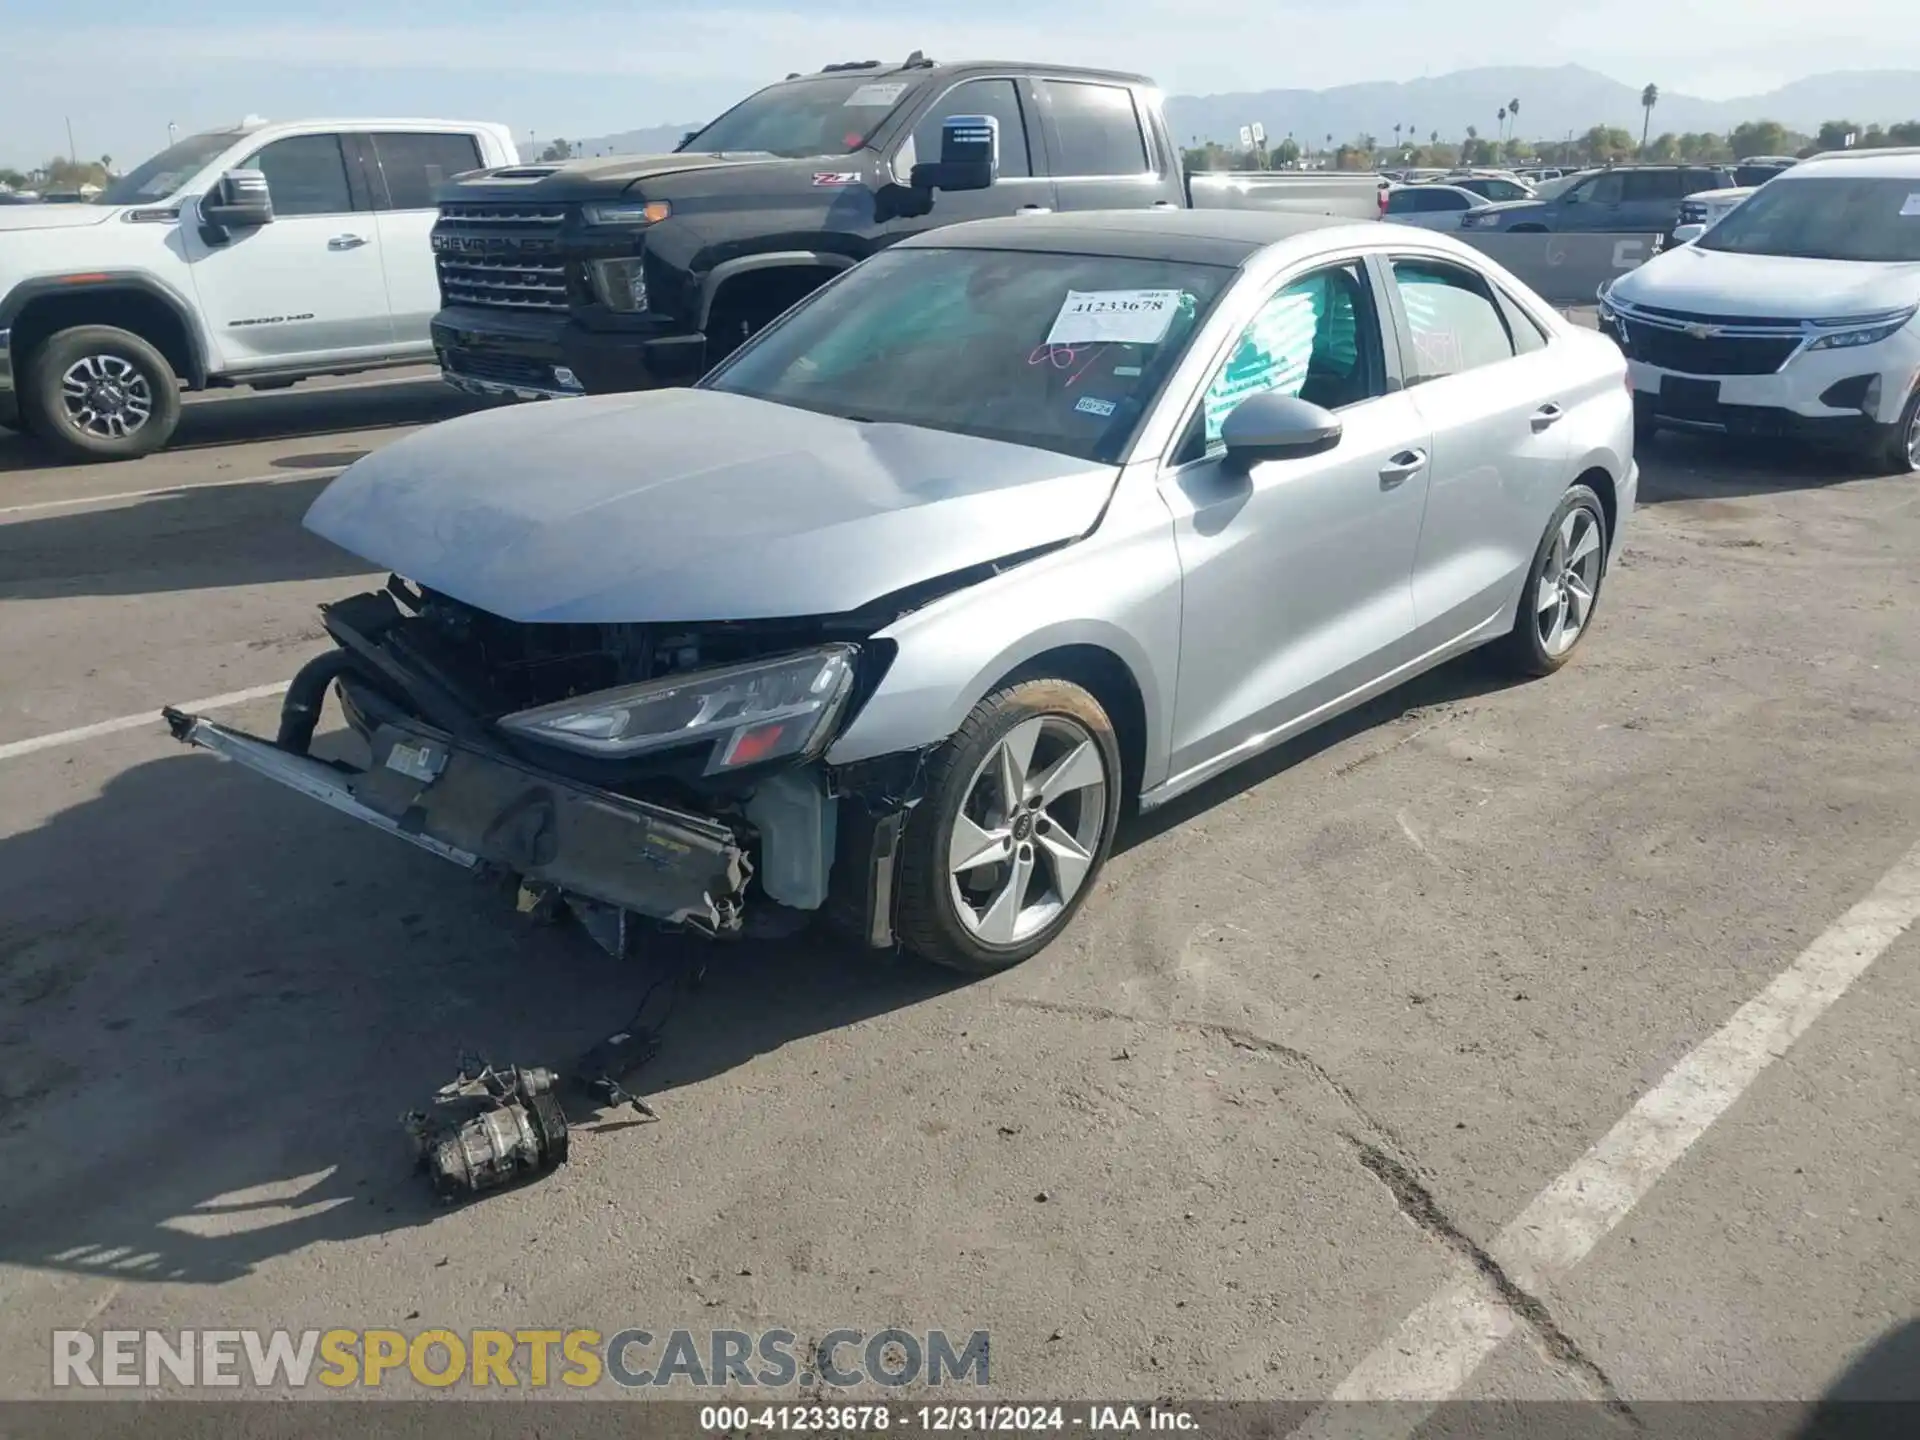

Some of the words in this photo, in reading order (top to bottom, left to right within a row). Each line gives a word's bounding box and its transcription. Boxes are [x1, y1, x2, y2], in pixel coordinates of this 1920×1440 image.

[812, 172, 861, 185] Z71
[431, 236, 556, 253] CHEVROLET
[1072, 300, 1164, 313] 41233678
[286, 313, 315, 321] HD
